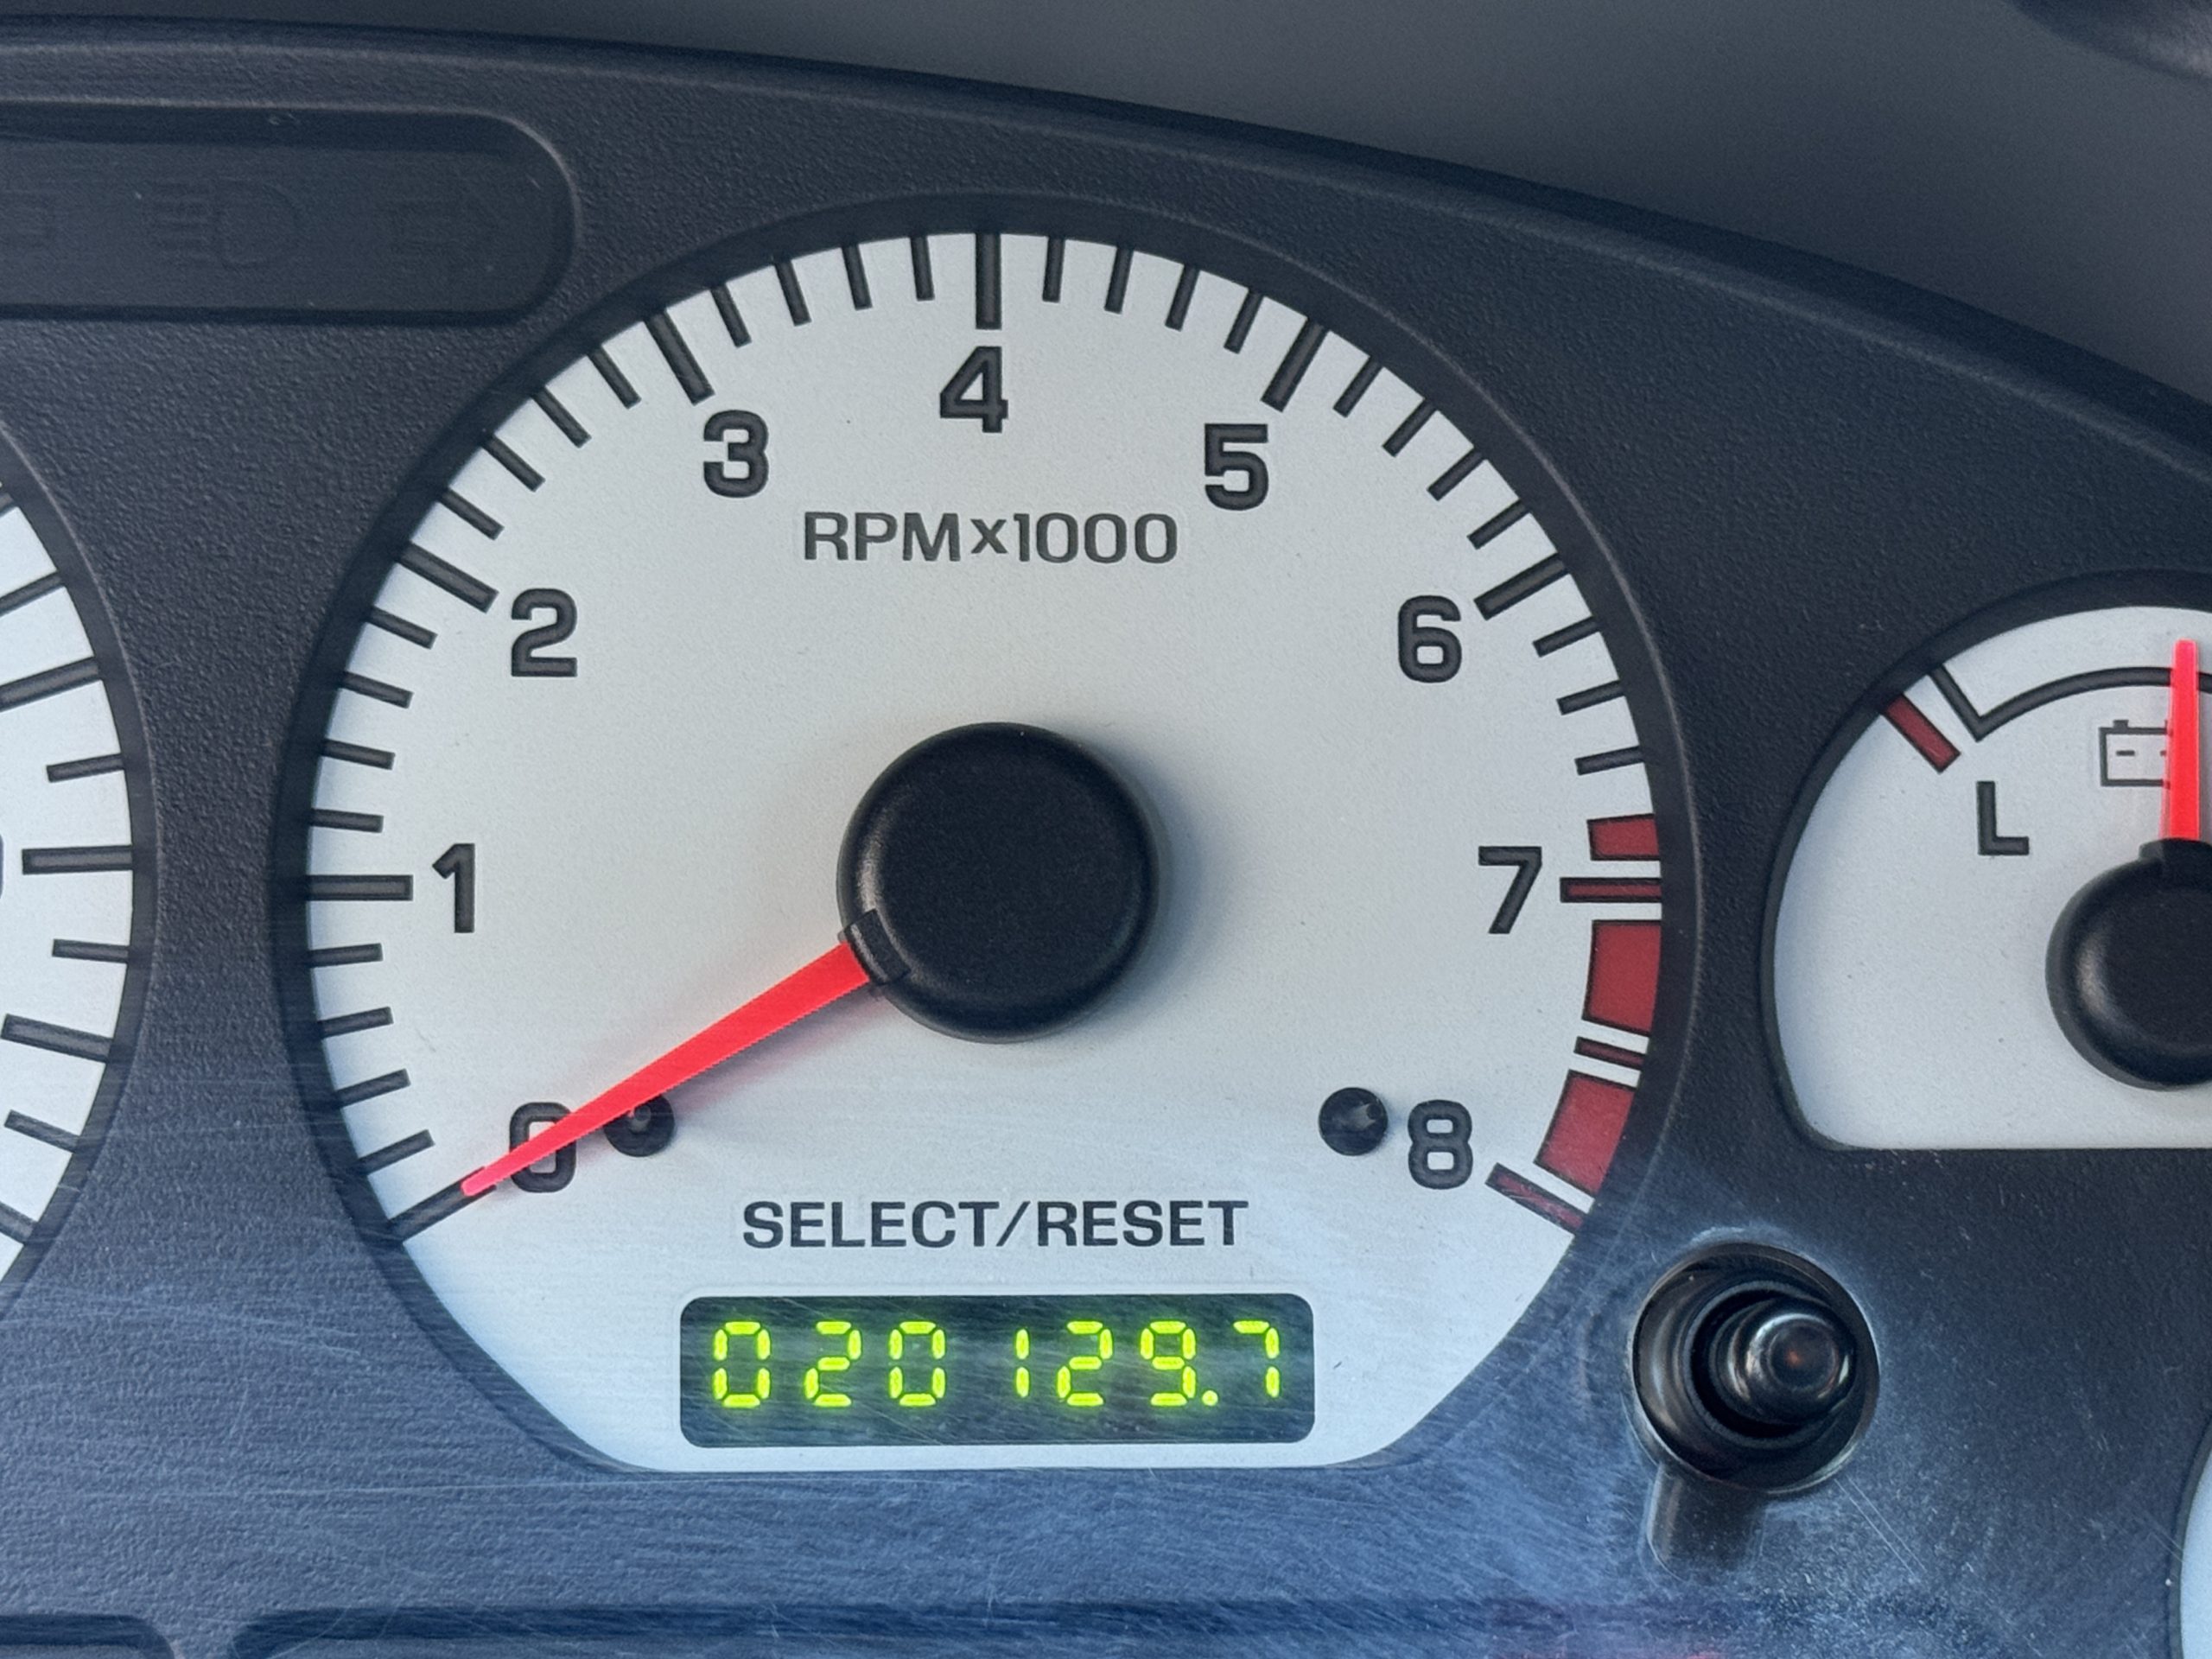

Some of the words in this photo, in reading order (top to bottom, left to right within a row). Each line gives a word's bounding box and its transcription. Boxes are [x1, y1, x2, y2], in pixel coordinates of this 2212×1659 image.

[940, 346, 1008, 433] 4
[703, 410, 768, 498] 3
[1205, 423, 1268, 511] 5
[511, 588, 577, 677] 2
[1398, 595, 1462, 683] 6
[1976, 781, 2030, 856] L
[432, 843, 474, 933] 1
[1478, 846, 1543, 935] 7
[509, 1102, 576, 1193] 0
[1408, 1099, 1473, 1190] 8
[743, 1199, 1249, 1249] SELECT/RESET
[712, 1319, 1281, 1408] 020129.7
